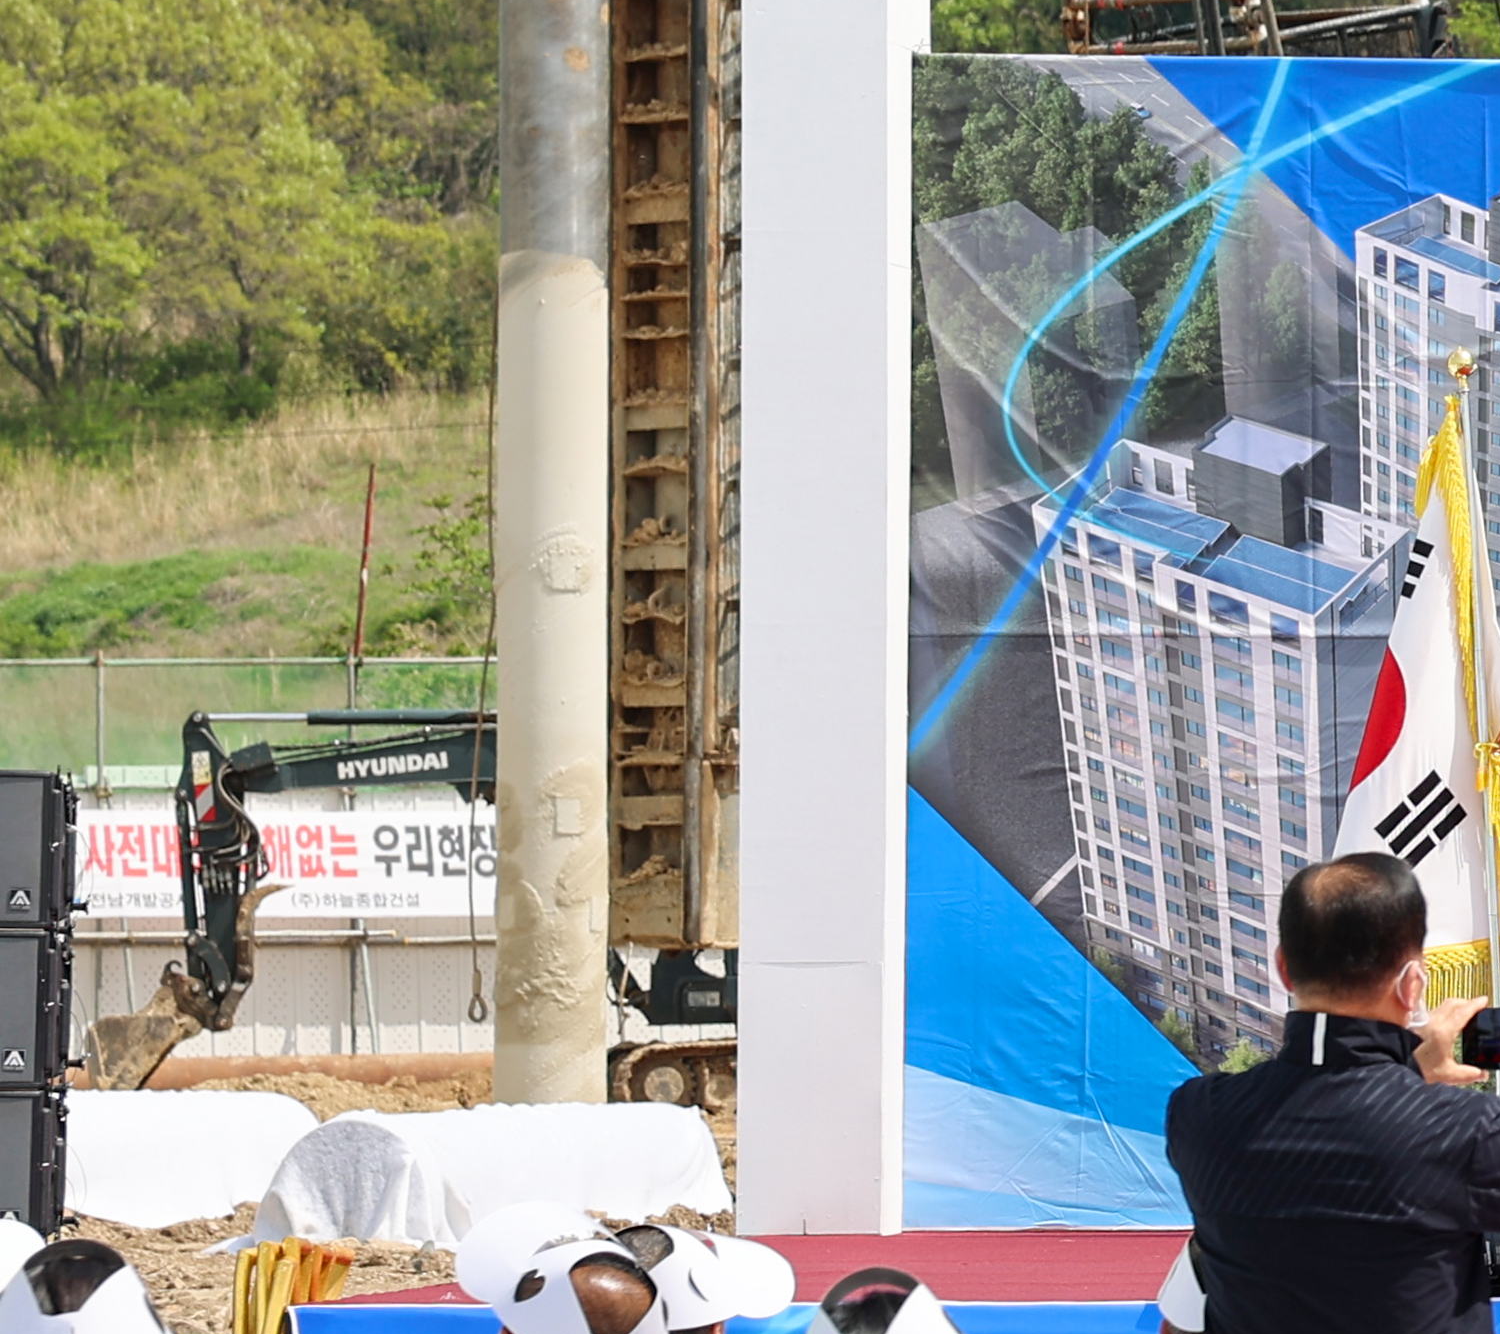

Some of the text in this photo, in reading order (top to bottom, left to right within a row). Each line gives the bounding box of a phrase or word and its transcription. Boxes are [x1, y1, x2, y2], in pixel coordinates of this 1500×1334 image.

[337, 750, 449, 781] HYUNDAI
[85, 824, 497, 879] 사전대 해없는 우리현장
